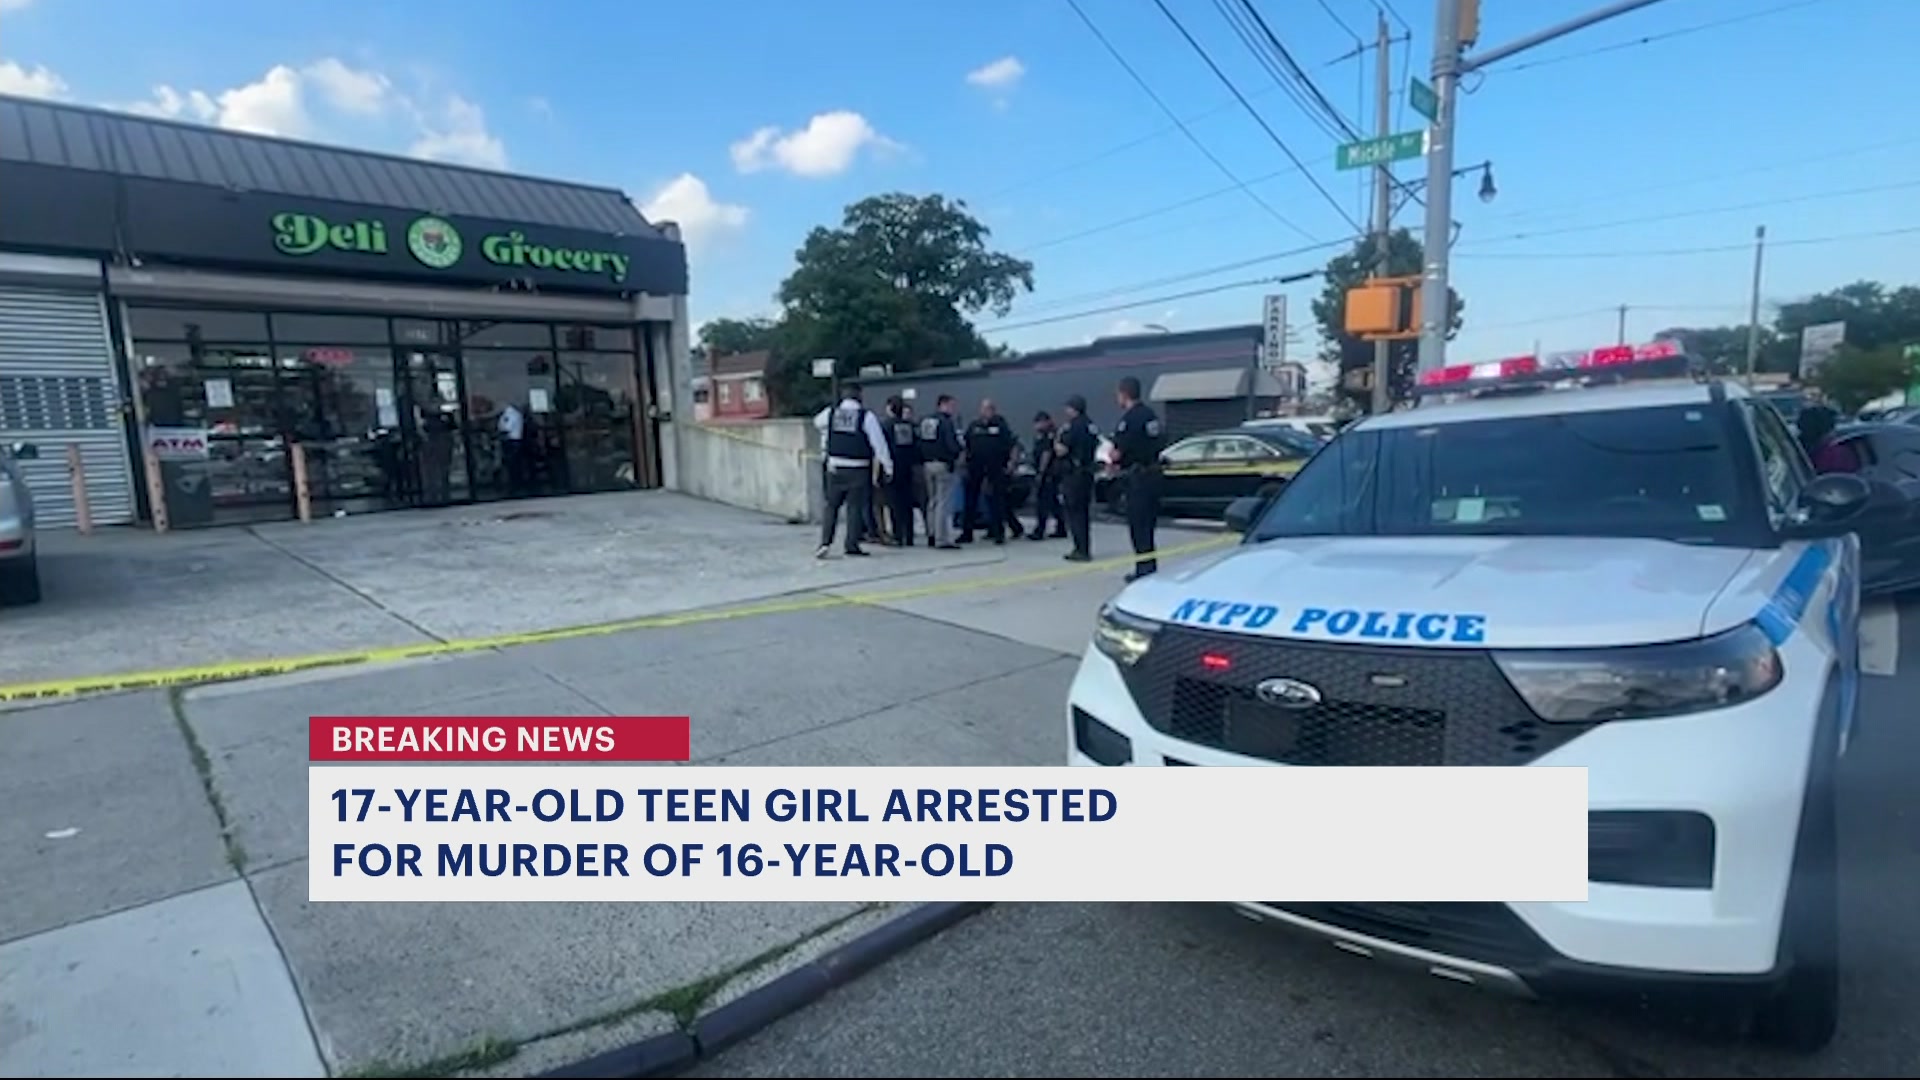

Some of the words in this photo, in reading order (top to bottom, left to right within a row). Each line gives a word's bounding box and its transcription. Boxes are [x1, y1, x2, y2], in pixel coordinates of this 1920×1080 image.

[272, 213, 387, 255] Deli
[482, 231, 629, 283] Grocery
[152, 438, 204, 450] ATM
[1171, 597, 1279, 630] NYPD
[1292, 607, 1486, 643] POLICE
